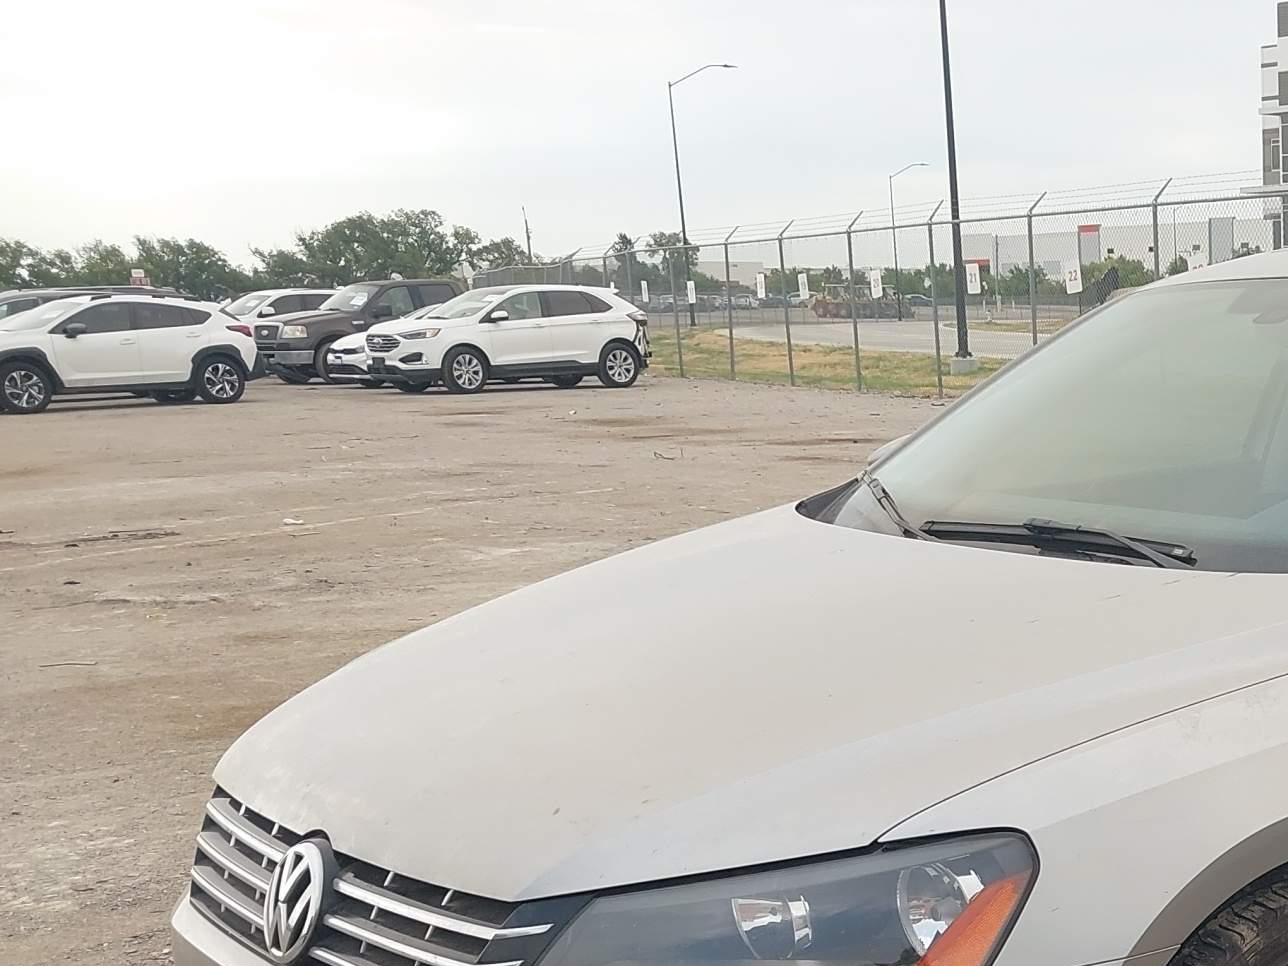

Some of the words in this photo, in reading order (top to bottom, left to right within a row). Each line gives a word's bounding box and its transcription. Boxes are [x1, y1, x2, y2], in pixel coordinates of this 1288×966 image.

[968, 272, 977, 283] 21
[1068, 270, 1078, 282] 22
[265, 843, 323, 960] VW
